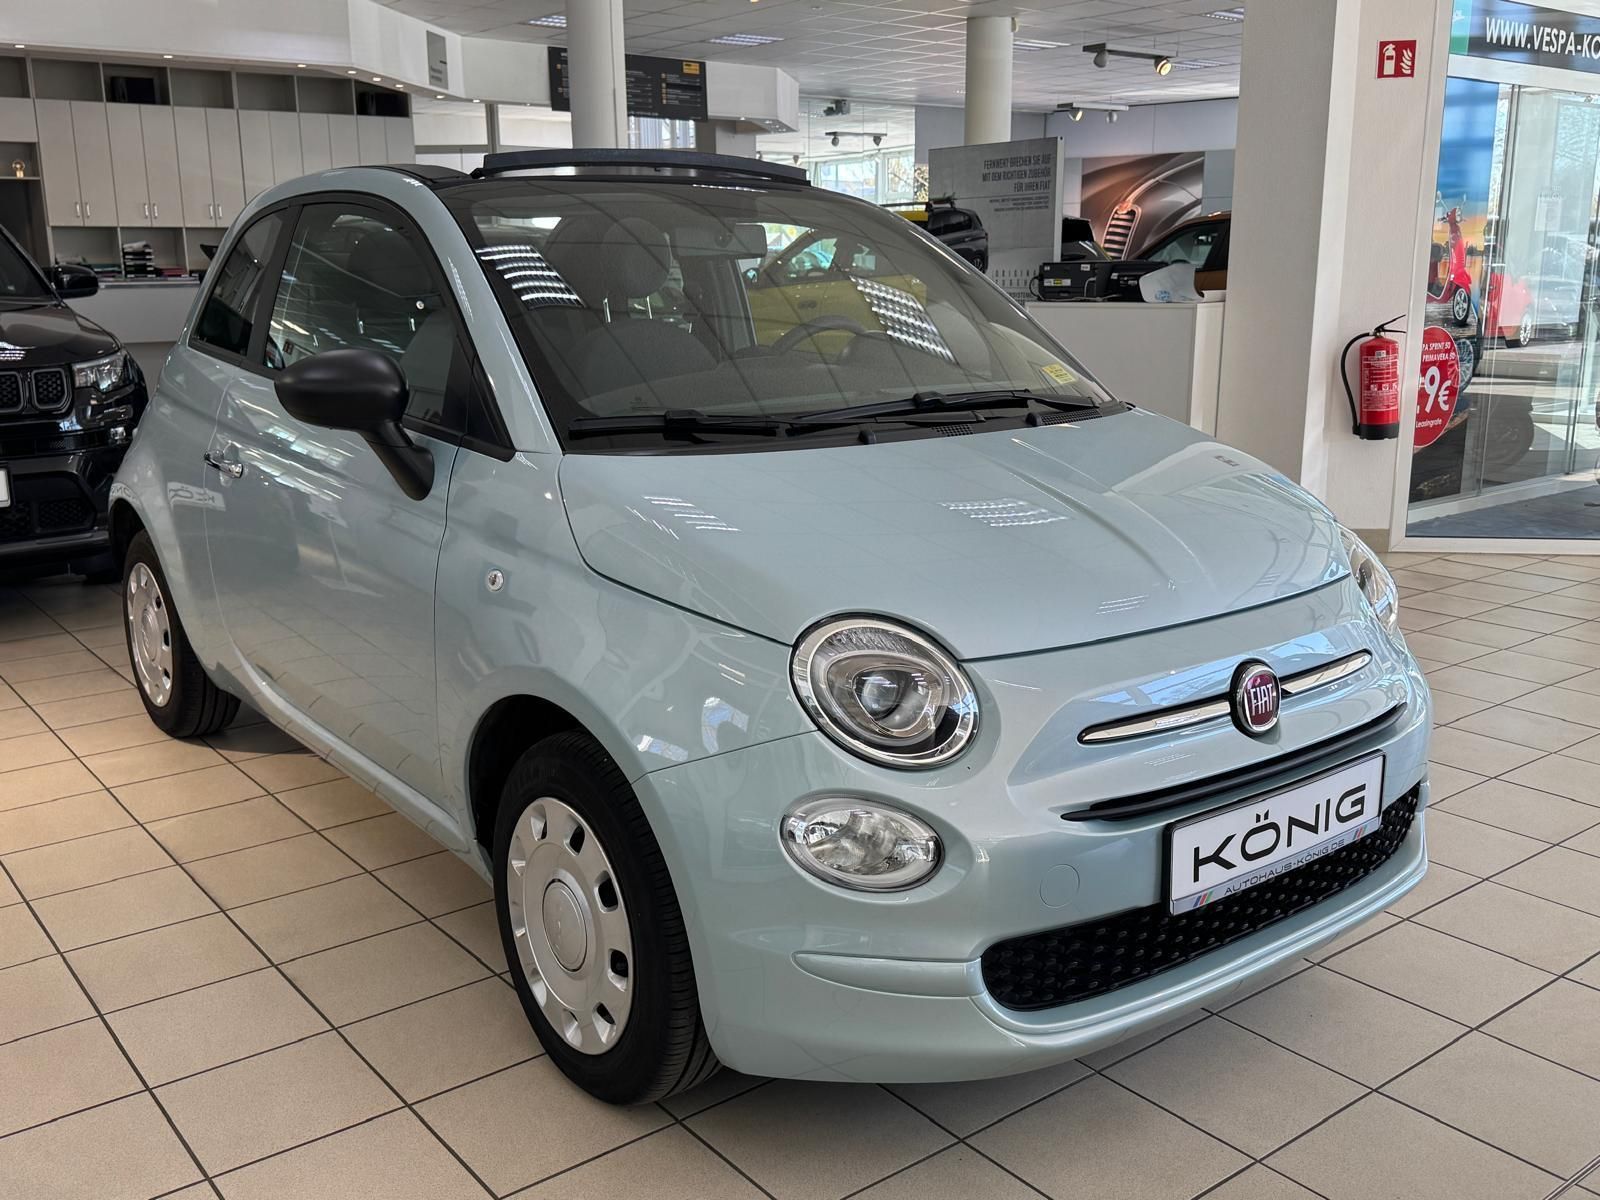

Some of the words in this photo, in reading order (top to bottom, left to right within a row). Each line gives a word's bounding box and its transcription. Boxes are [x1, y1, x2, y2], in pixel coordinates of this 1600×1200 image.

[982, 172, 991, 183] MIT
[1039, 180, 1051, 191] FIAT
[1429, 342, 1444, 351] SPRINT
[1444, 341, 1451, 349] 50
[1422, 352, 1448, 362] PRIMAVERA
[1248, 683, 1273, 716] FIAT
[1193, 783, 1367, 883] KÖNIG
